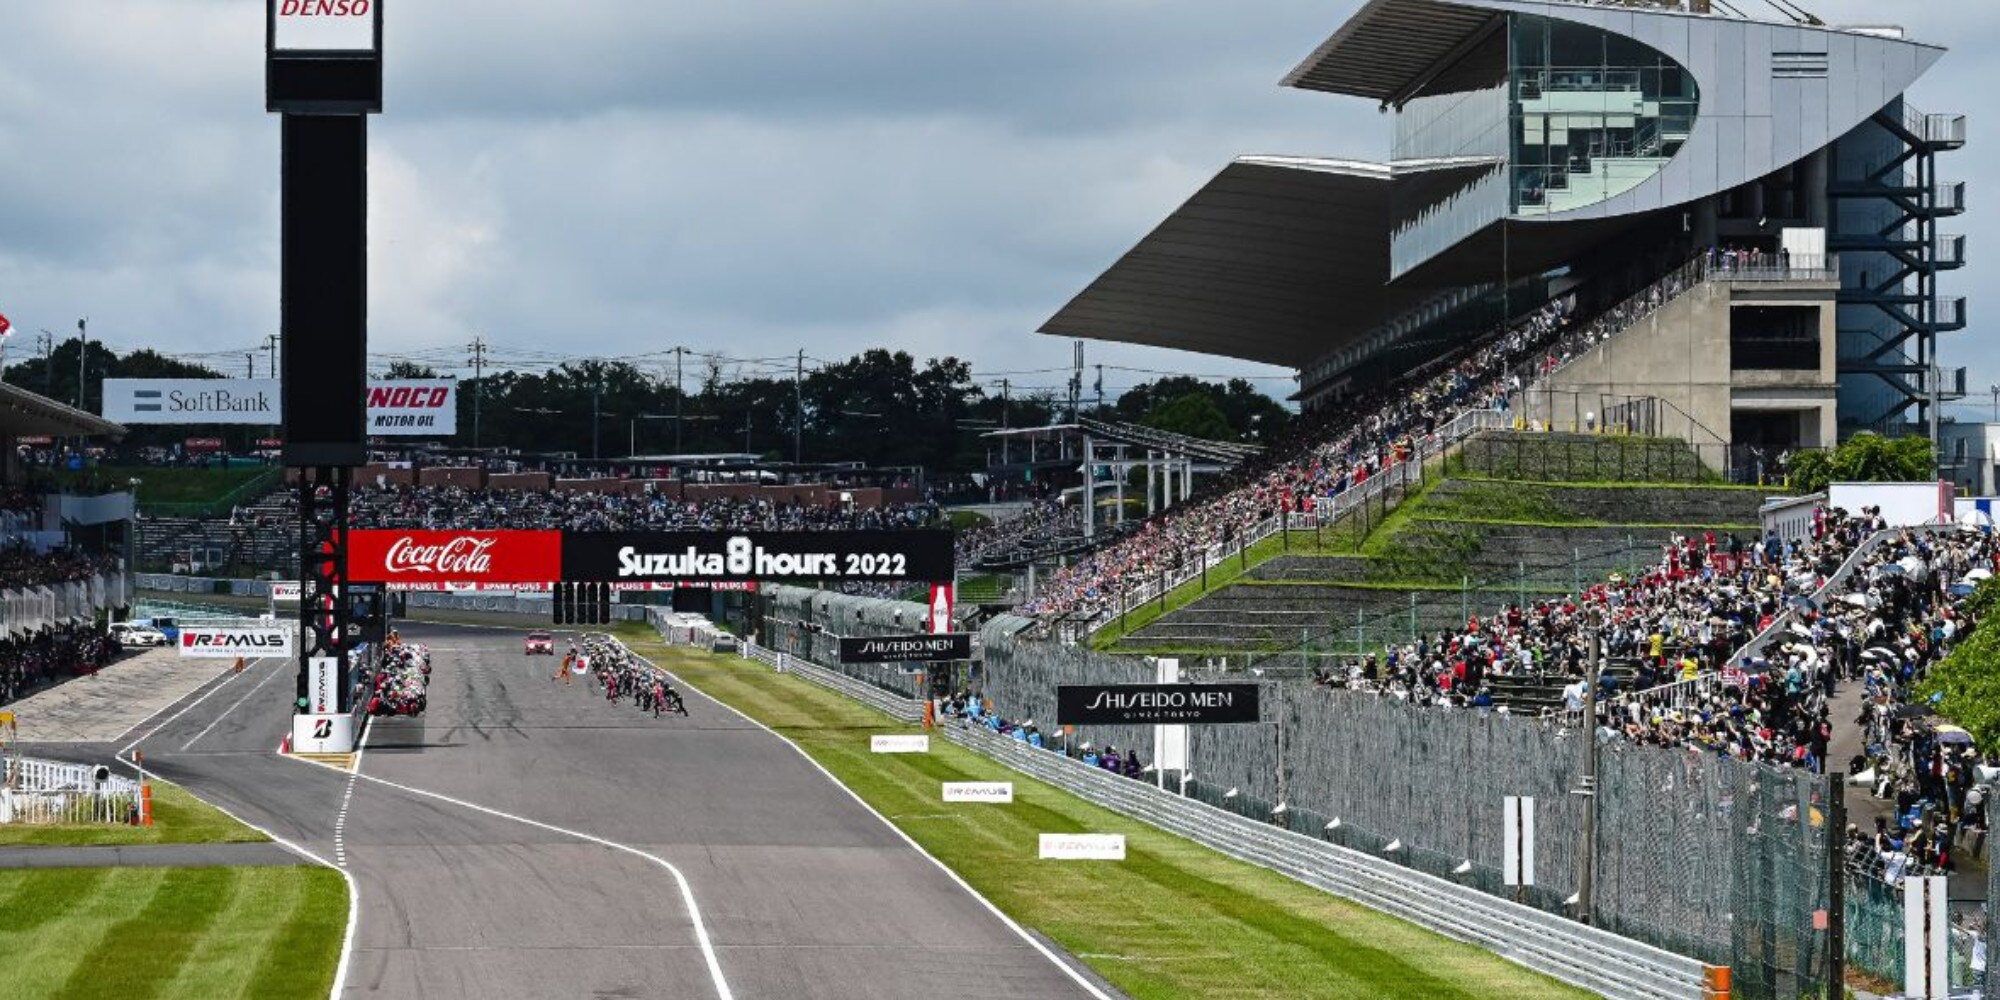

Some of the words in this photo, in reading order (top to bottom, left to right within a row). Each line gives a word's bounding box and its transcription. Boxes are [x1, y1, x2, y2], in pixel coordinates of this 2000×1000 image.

[280, 0, 370, 16] DENSO
[169, 390, 271, 412] SoftBank
[375, 416, 415, 427] MOTOR
[417, 416, 434, 427] OIL
[618, 546, 723, 576] Suzuka
[726, 536, 752, 575] 8
[845, 553, 906, 576] 2022
[195, 633, 284, 646] REMUS
[858, 641, 923, 653] SHISEIDO
[926, 639, 954, 651] MEN
[1086, 690, 1186, 709] SHISEIDO
[1190, 692, 1233, 708] MEN
